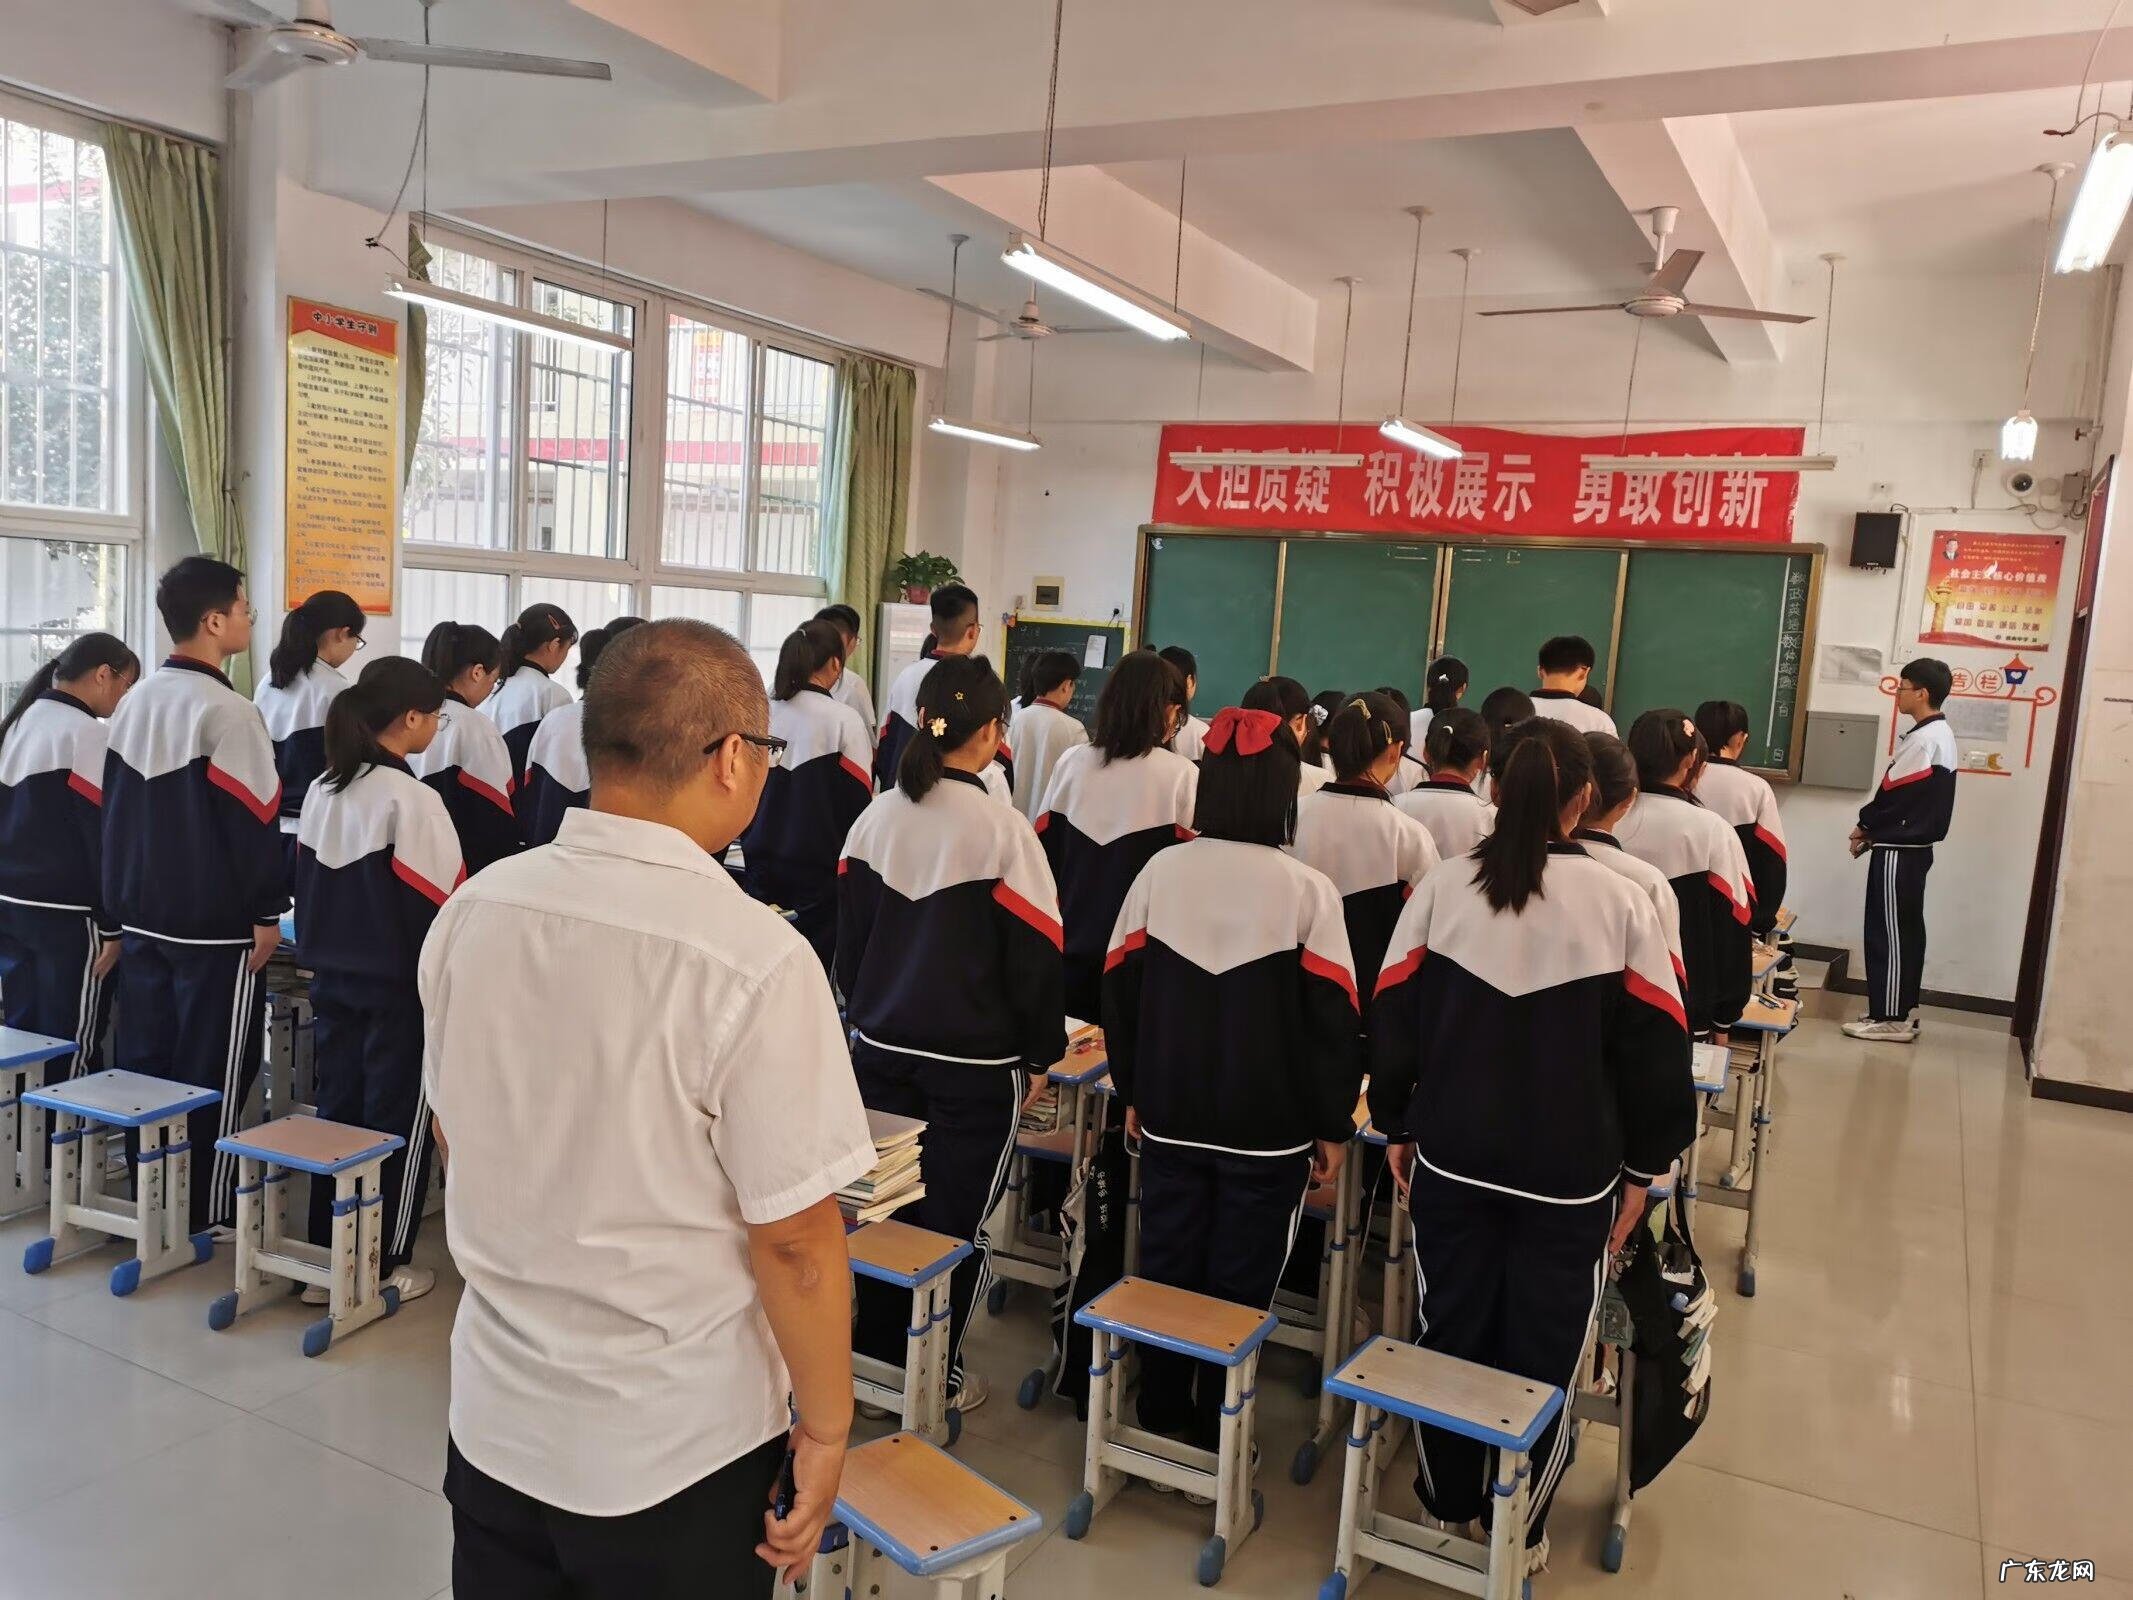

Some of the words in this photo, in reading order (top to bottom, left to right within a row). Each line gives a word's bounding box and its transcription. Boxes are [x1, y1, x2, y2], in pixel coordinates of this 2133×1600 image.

[1176, 446, 1331, 514] 大胆质疑
[1364, 450, 1536, 522] 积极展示
[1573, 451, 1769, 529] 勇敢创新
